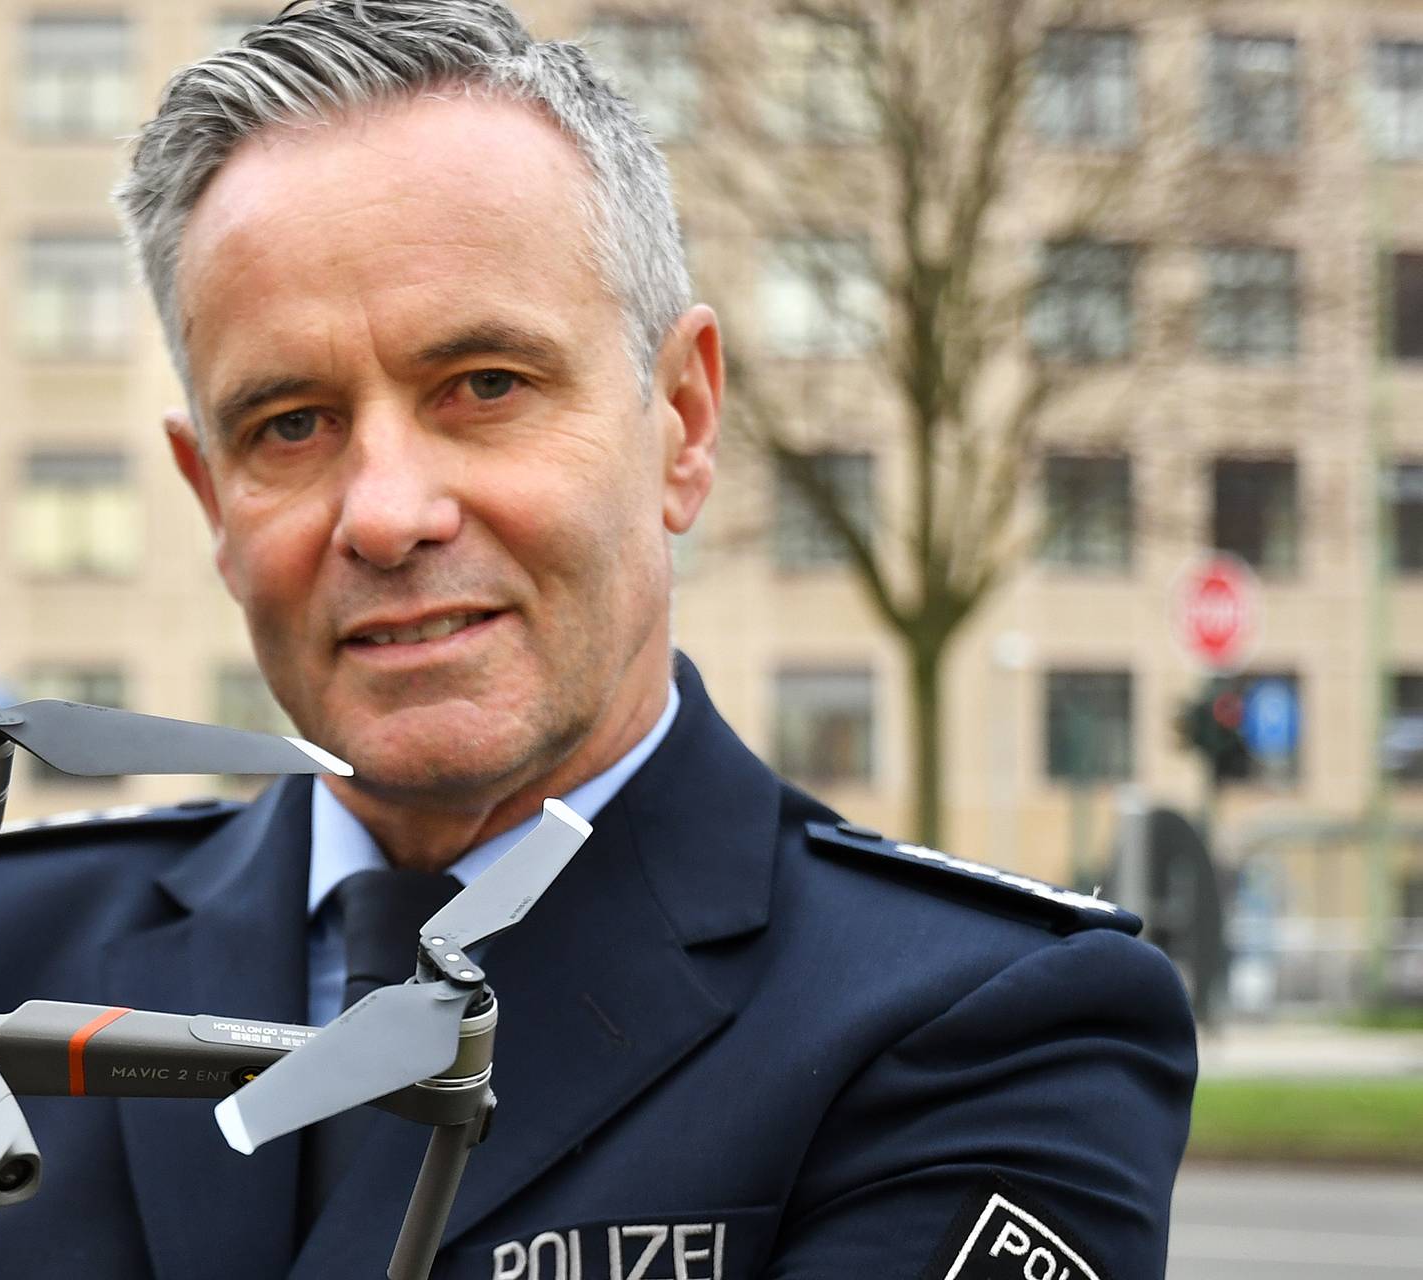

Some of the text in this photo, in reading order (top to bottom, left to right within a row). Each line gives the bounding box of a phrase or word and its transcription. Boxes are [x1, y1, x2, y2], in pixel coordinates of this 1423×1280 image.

[213, 1022, 247, 1033] TOUCH
[247, 1026, 262, 1034] NO
[263, 1028, 278, 1036] DO
[111, 1066, 170, 1079] MAVIC
[177, 1069, 188, 1080] 2
